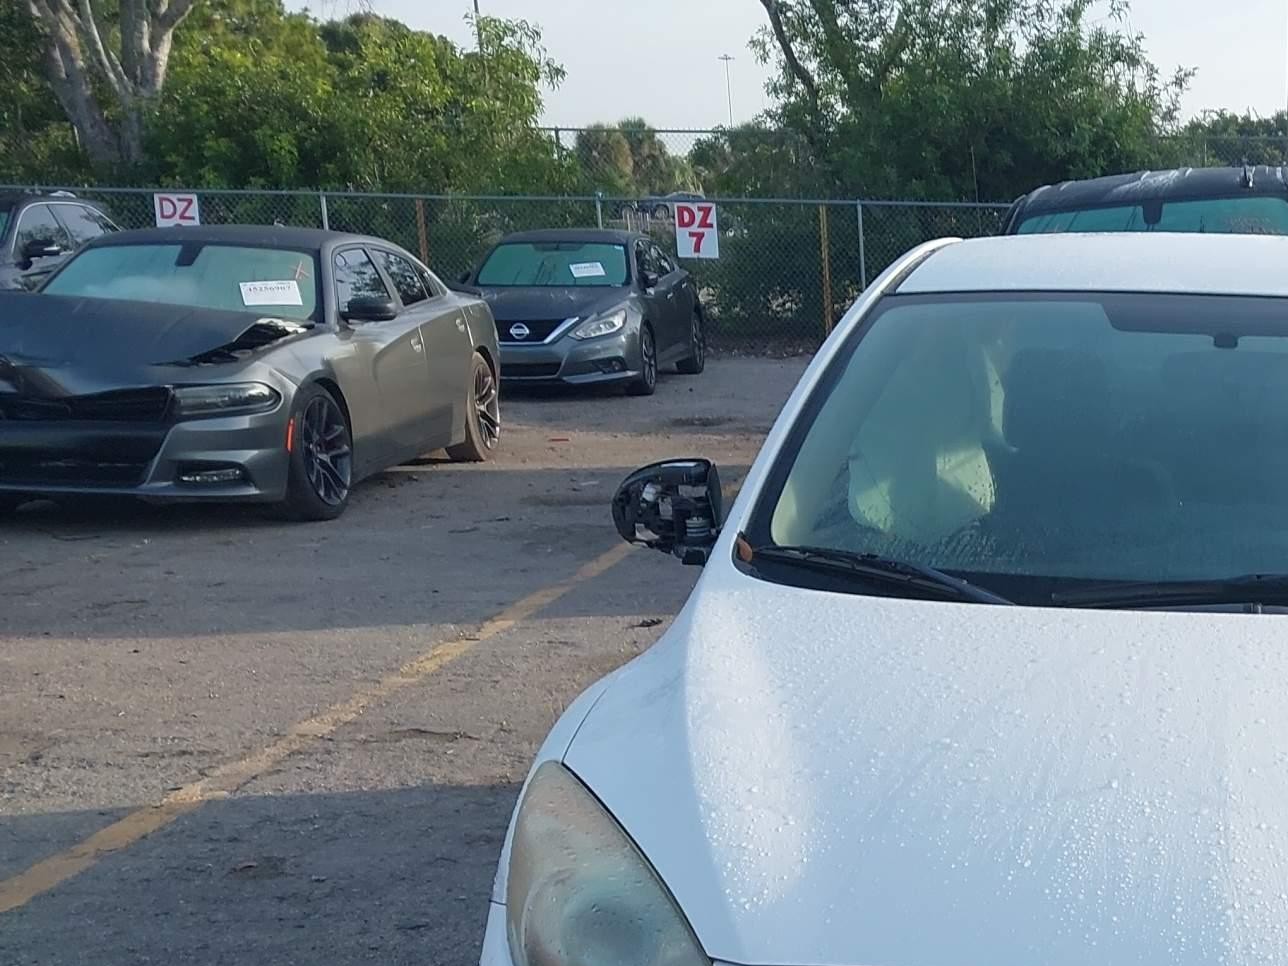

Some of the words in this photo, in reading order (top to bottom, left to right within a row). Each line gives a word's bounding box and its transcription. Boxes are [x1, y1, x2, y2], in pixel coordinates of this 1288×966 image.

[158, 197, 195, 220] DZ
[677, 206, 713, 228] DZ
[688, 231, 705, 253] 7
